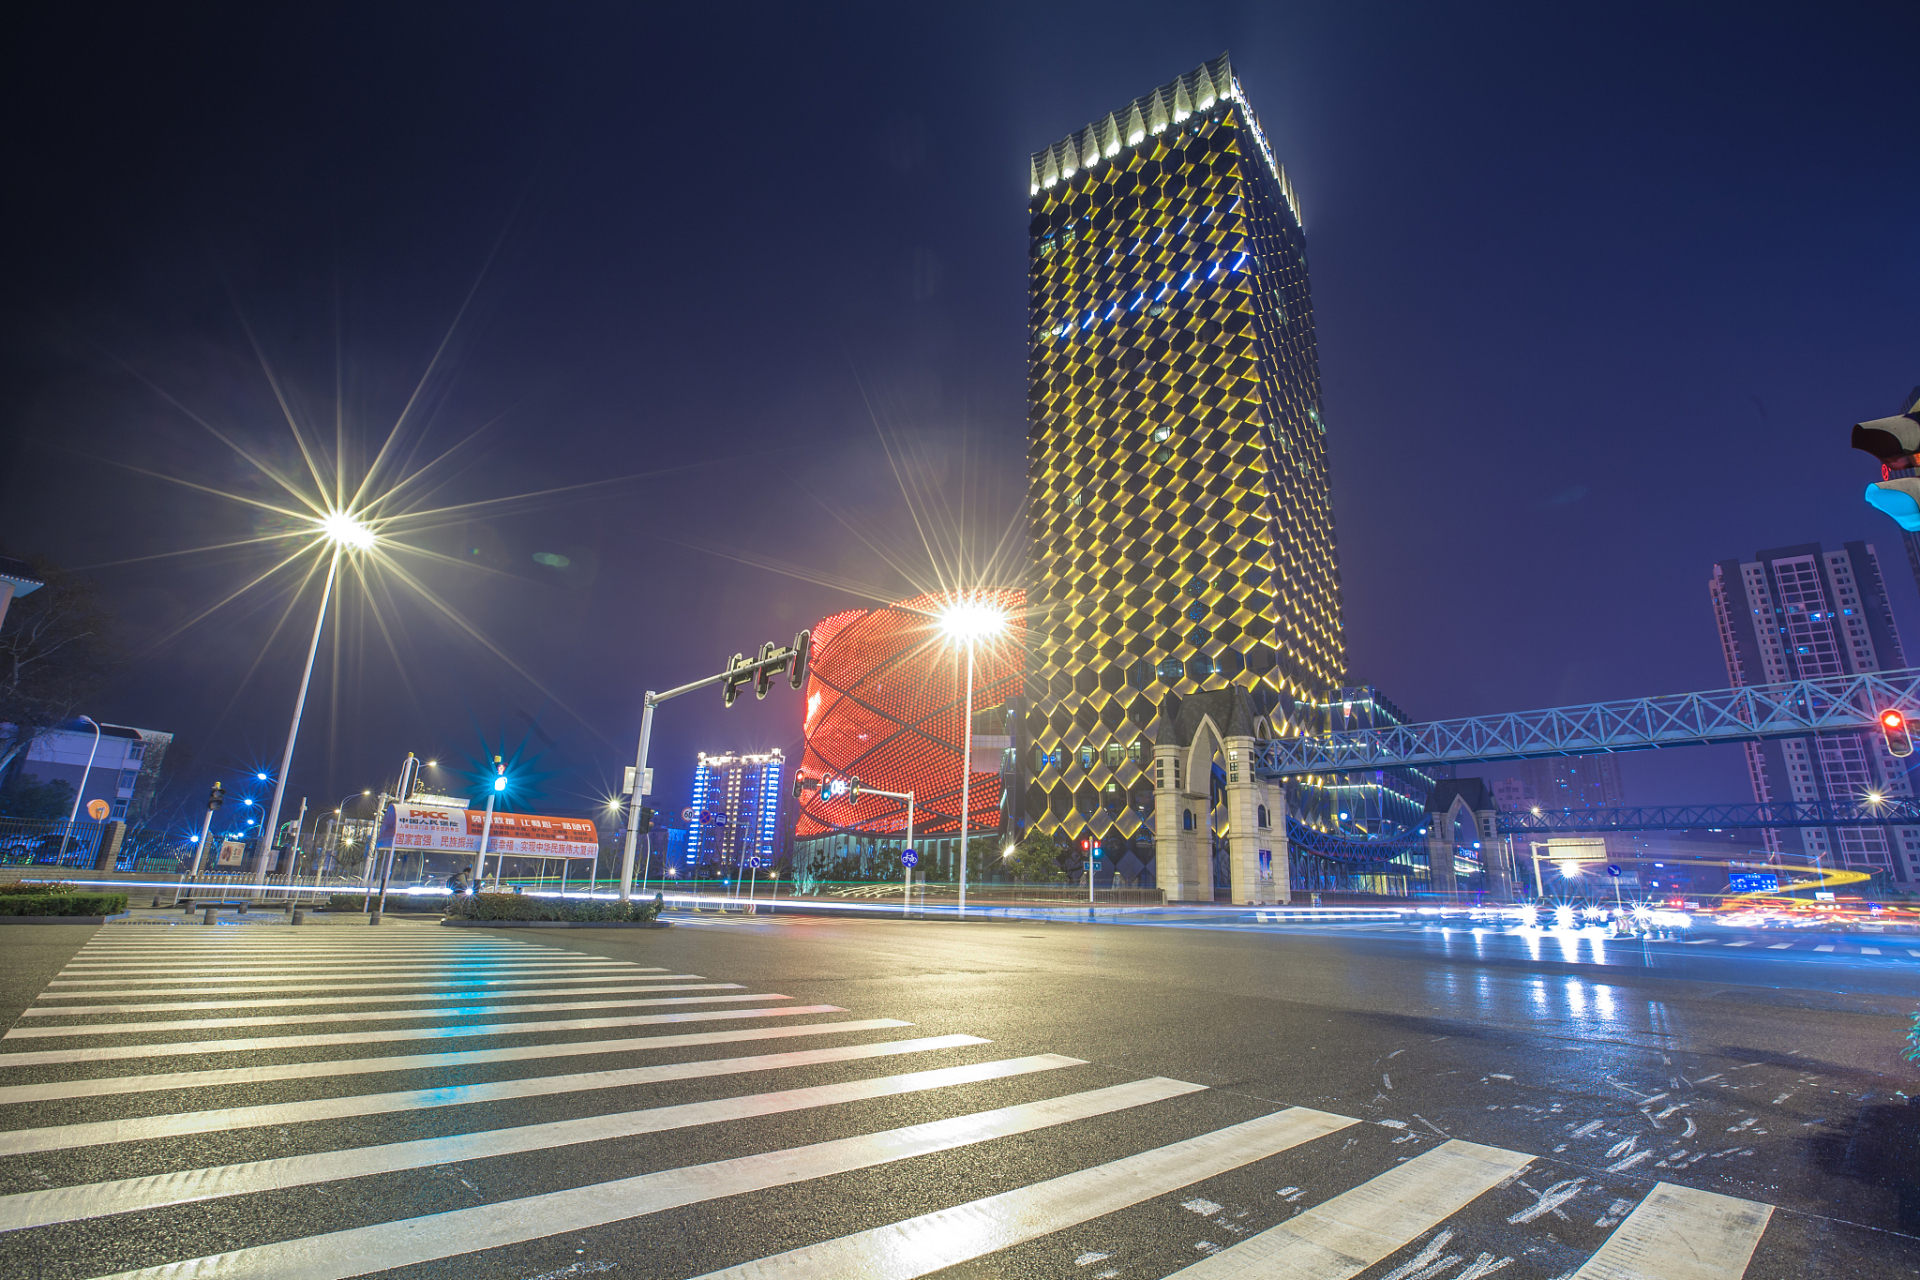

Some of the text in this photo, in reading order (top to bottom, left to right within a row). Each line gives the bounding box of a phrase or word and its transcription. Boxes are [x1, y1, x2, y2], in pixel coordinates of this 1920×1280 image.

[409, 810, 449, 820] PICC
[684, 811, 693, 819] 60
[399, 817, 459, 827] 中国人民保险
